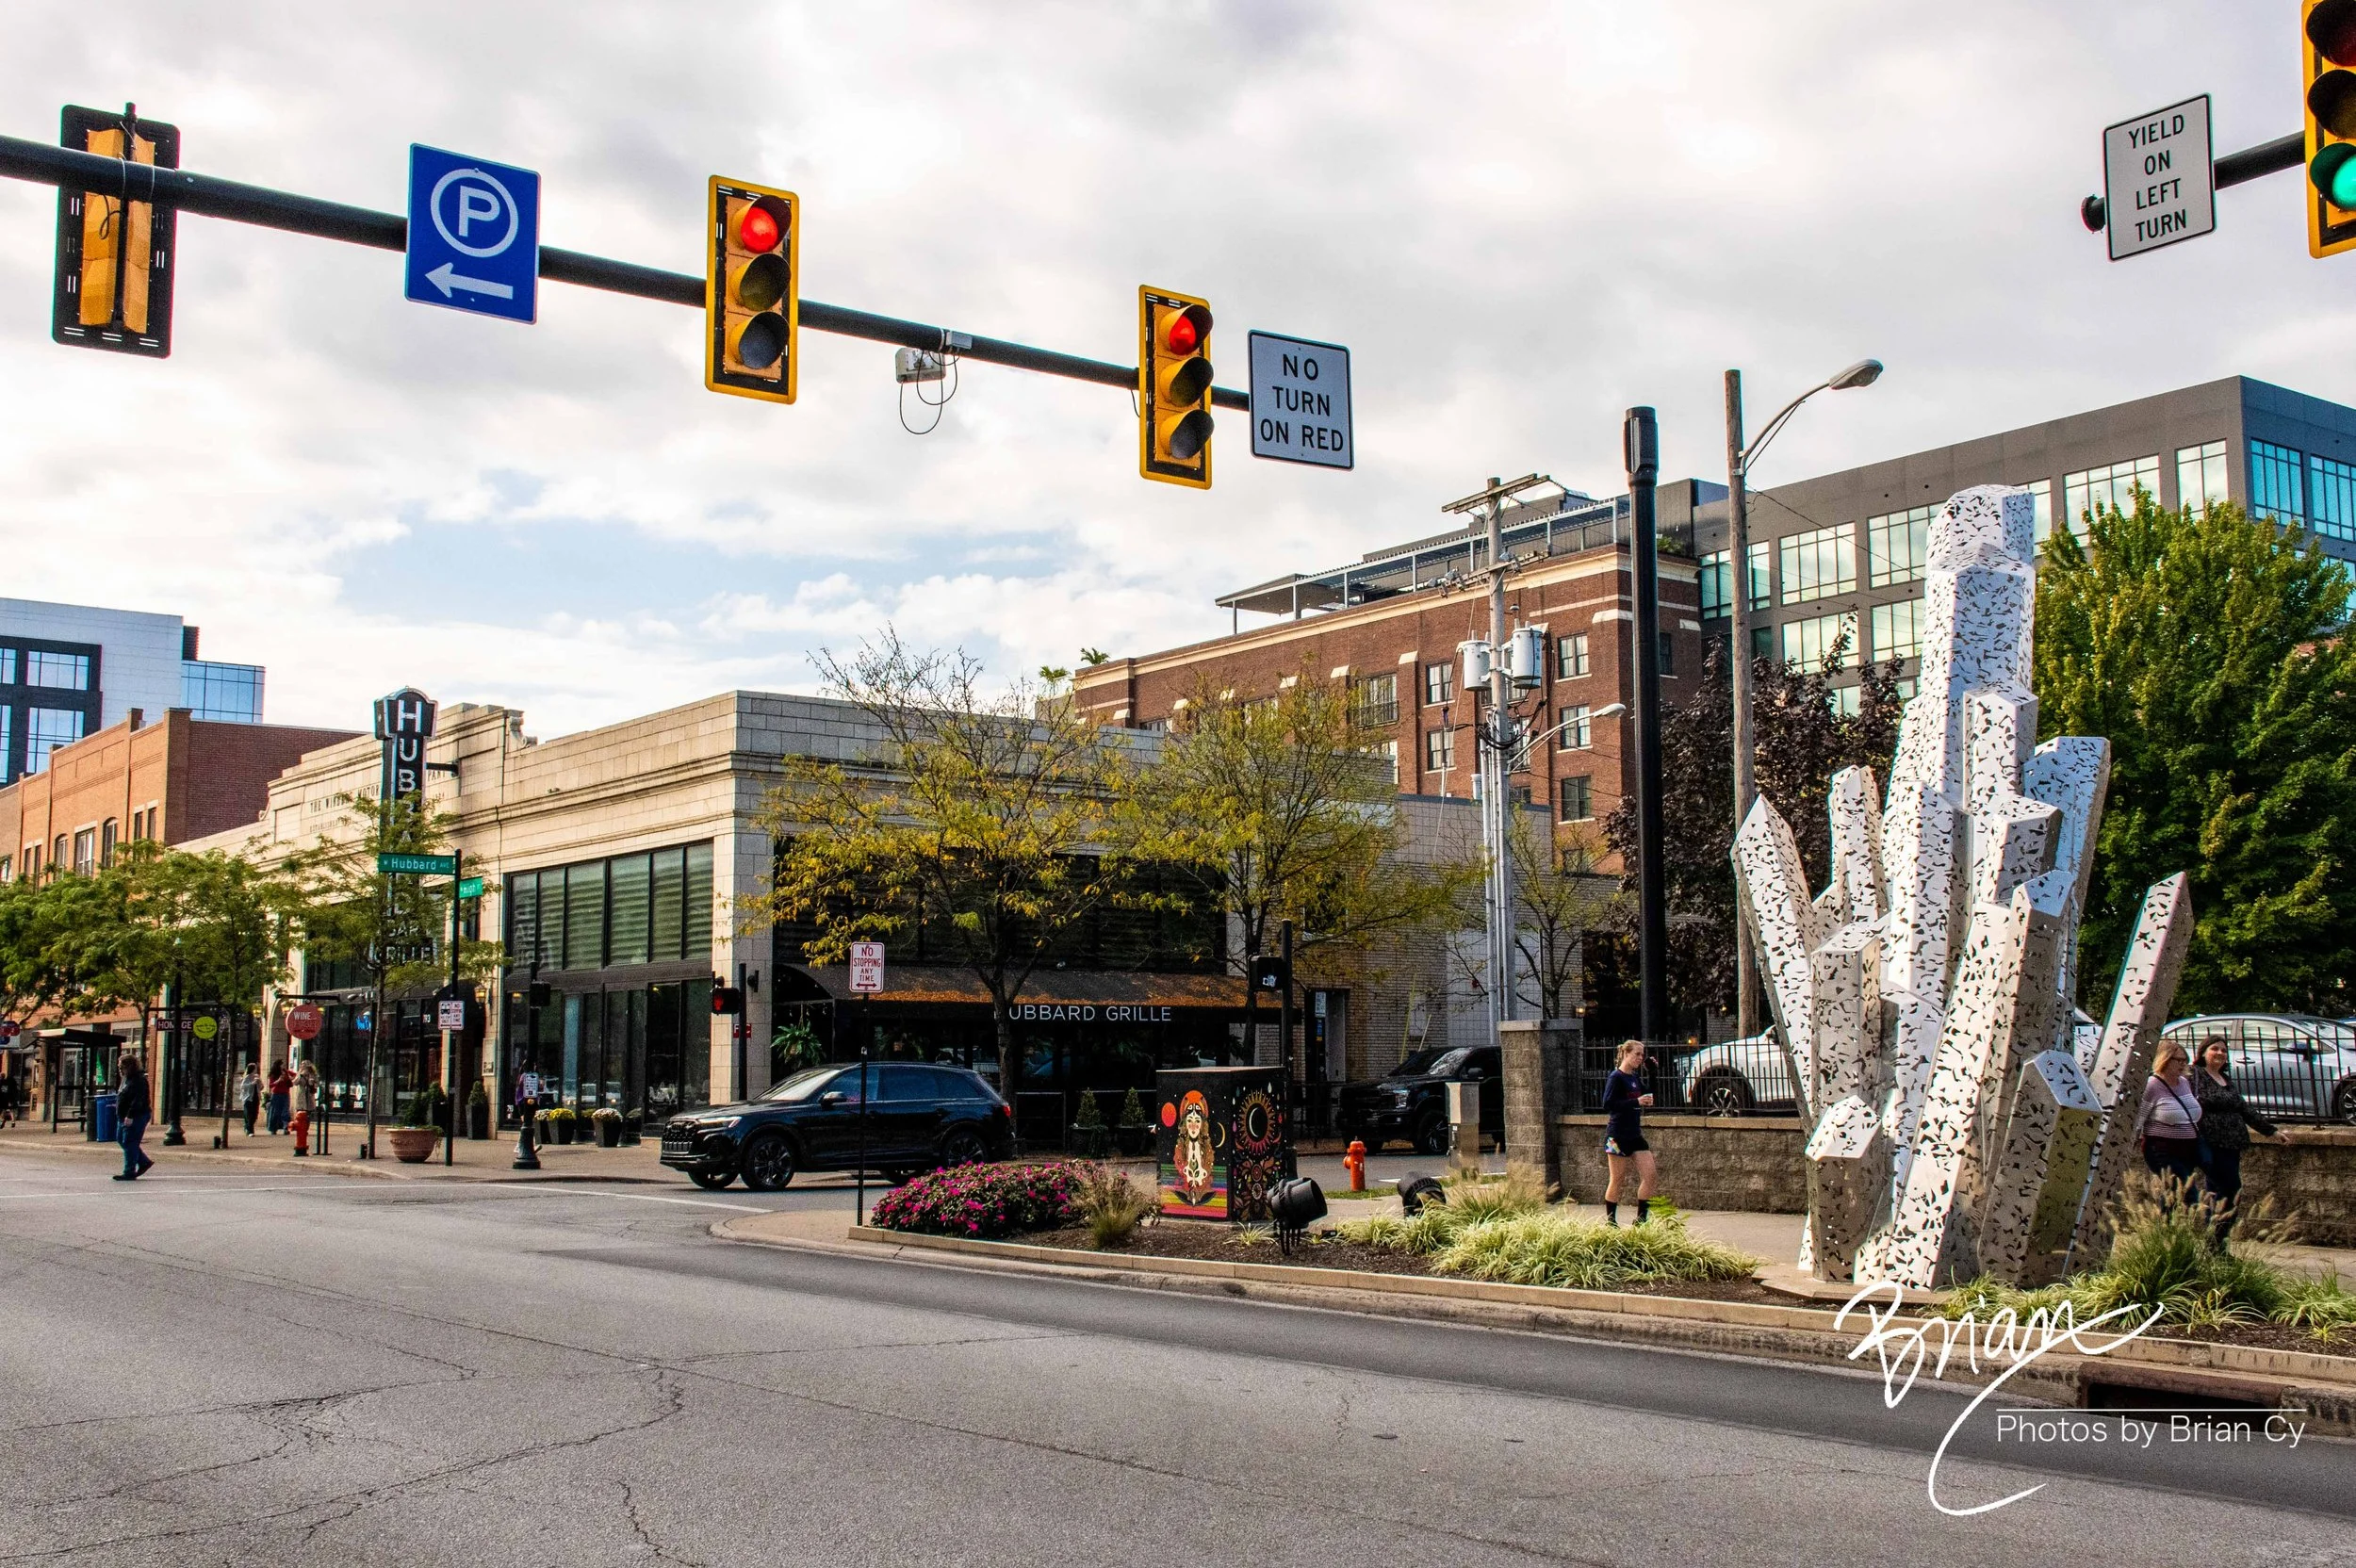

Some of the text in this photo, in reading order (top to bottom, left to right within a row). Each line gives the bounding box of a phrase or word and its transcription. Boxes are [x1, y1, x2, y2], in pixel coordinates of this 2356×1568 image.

[2128, 114, 2184, 150] YIELD
[2144, 149, 2171, 176] ON
[2135, 178, 2182, 210] LEFT
[458, 186, 501, 237] P
[2135, 208, 2187, 242] TURN
[1283, 352, 1319, 382] NO
[1272, 385, 1332, 417] TURN
[1259, 418, 1345, 452] ON RED
[391, 858, 437, 870] Hubbard
[853, 957, 881, 968] STOPPING
[861, 947, 874, 956] NO
[157, 1020, 192, 1030] HOMGE
[293, 1011, 311, 1021] WINE
[994, 1004, 1172, 1021] UBBARD GRILLE
